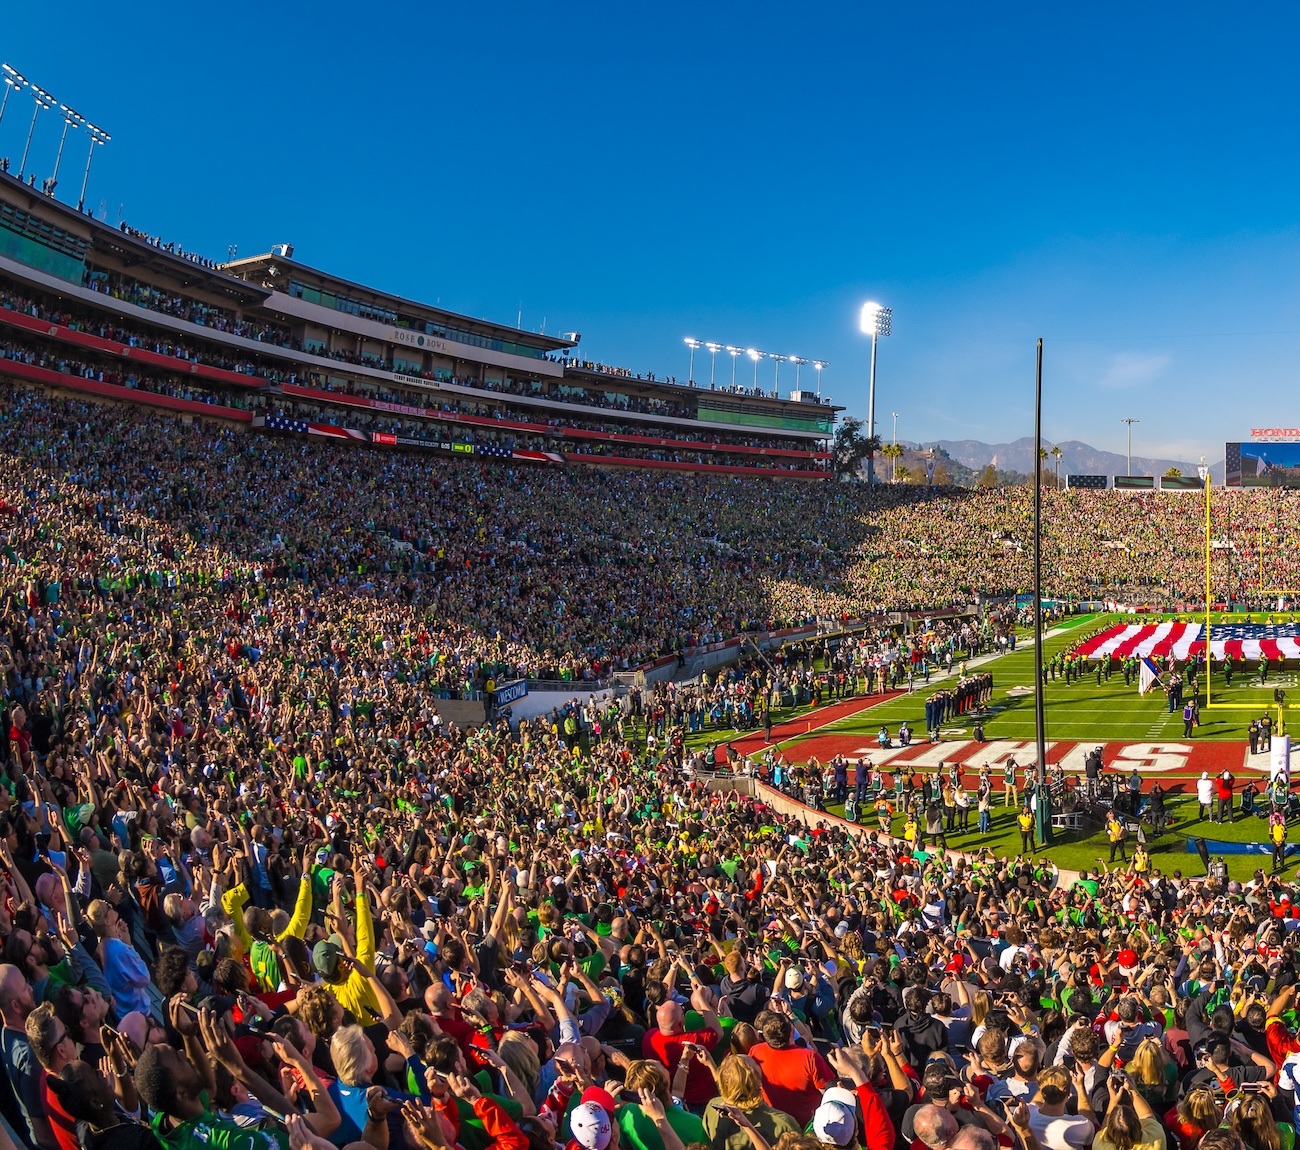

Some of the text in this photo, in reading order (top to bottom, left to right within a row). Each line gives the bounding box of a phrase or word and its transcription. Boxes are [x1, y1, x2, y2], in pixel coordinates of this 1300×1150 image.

[394, 331, 446, 350] ROSE BOWL
[500, 686, 521, 703] WESCOM
